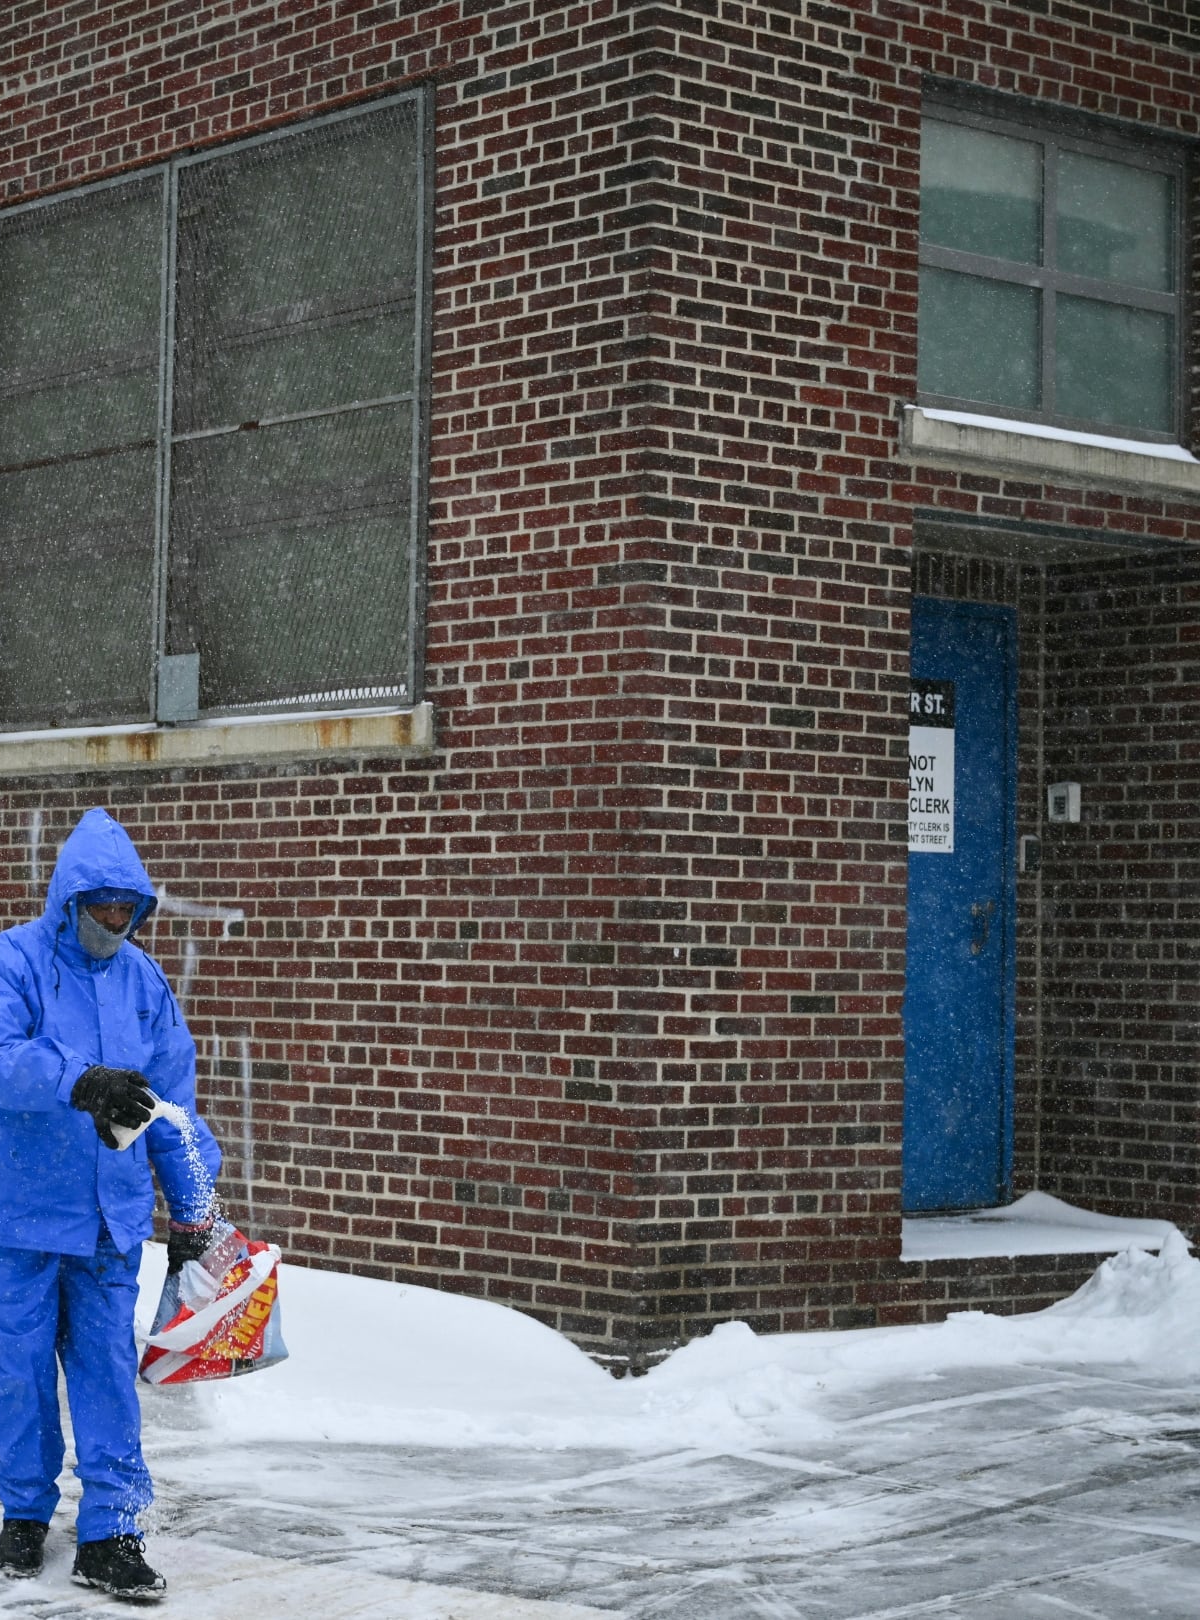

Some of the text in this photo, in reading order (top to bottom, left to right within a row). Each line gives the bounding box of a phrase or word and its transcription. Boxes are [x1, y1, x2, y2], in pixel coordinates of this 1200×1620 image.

[924, 693, 945, 715] ST.
[908, 755, 936, 772] NOT
[909, 797, 950, 815] CLERK
[919, 822, 941, 832] CLERK
[943, 823, 950, 833] IS
[909, 834, 947, 845] NT STREET
